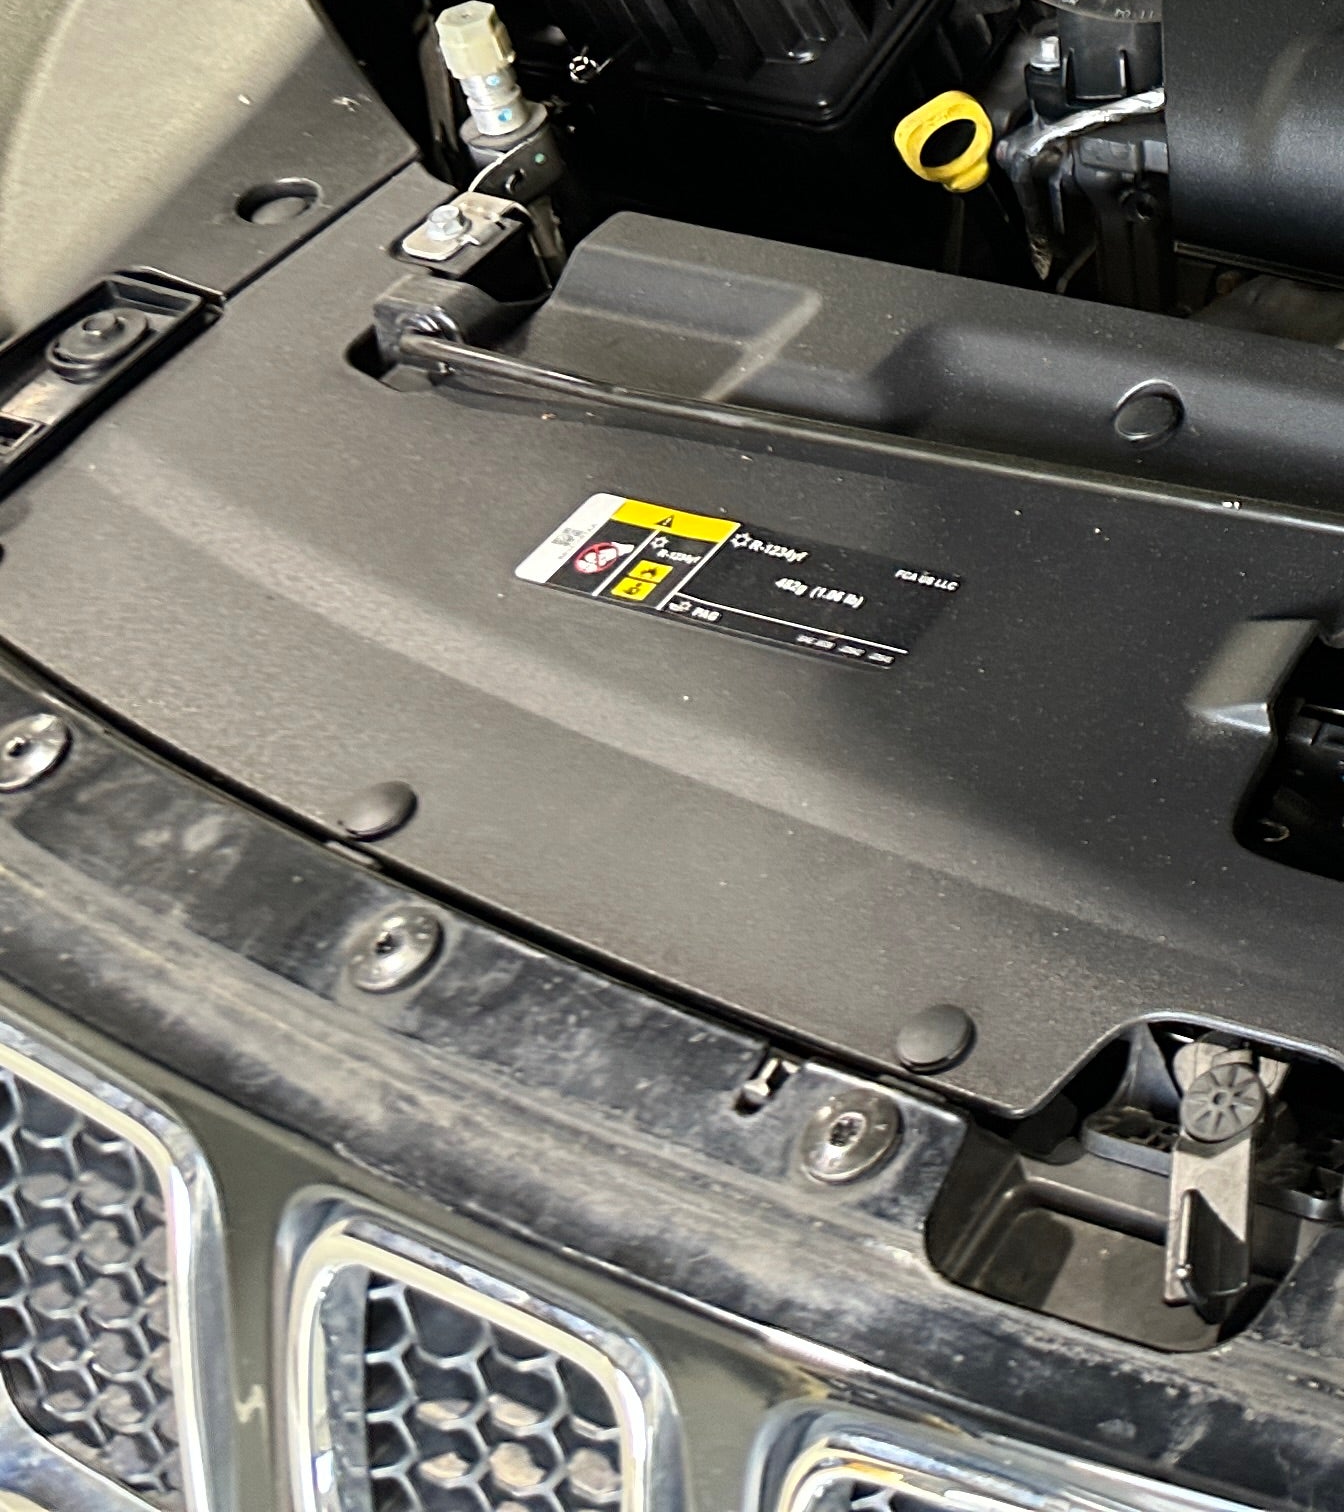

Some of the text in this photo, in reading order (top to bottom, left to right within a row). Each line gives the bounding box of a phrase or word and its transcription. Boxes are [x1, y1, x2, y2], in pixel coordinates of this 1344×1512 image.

[895, 569, 959, 591] FCA US LLC
